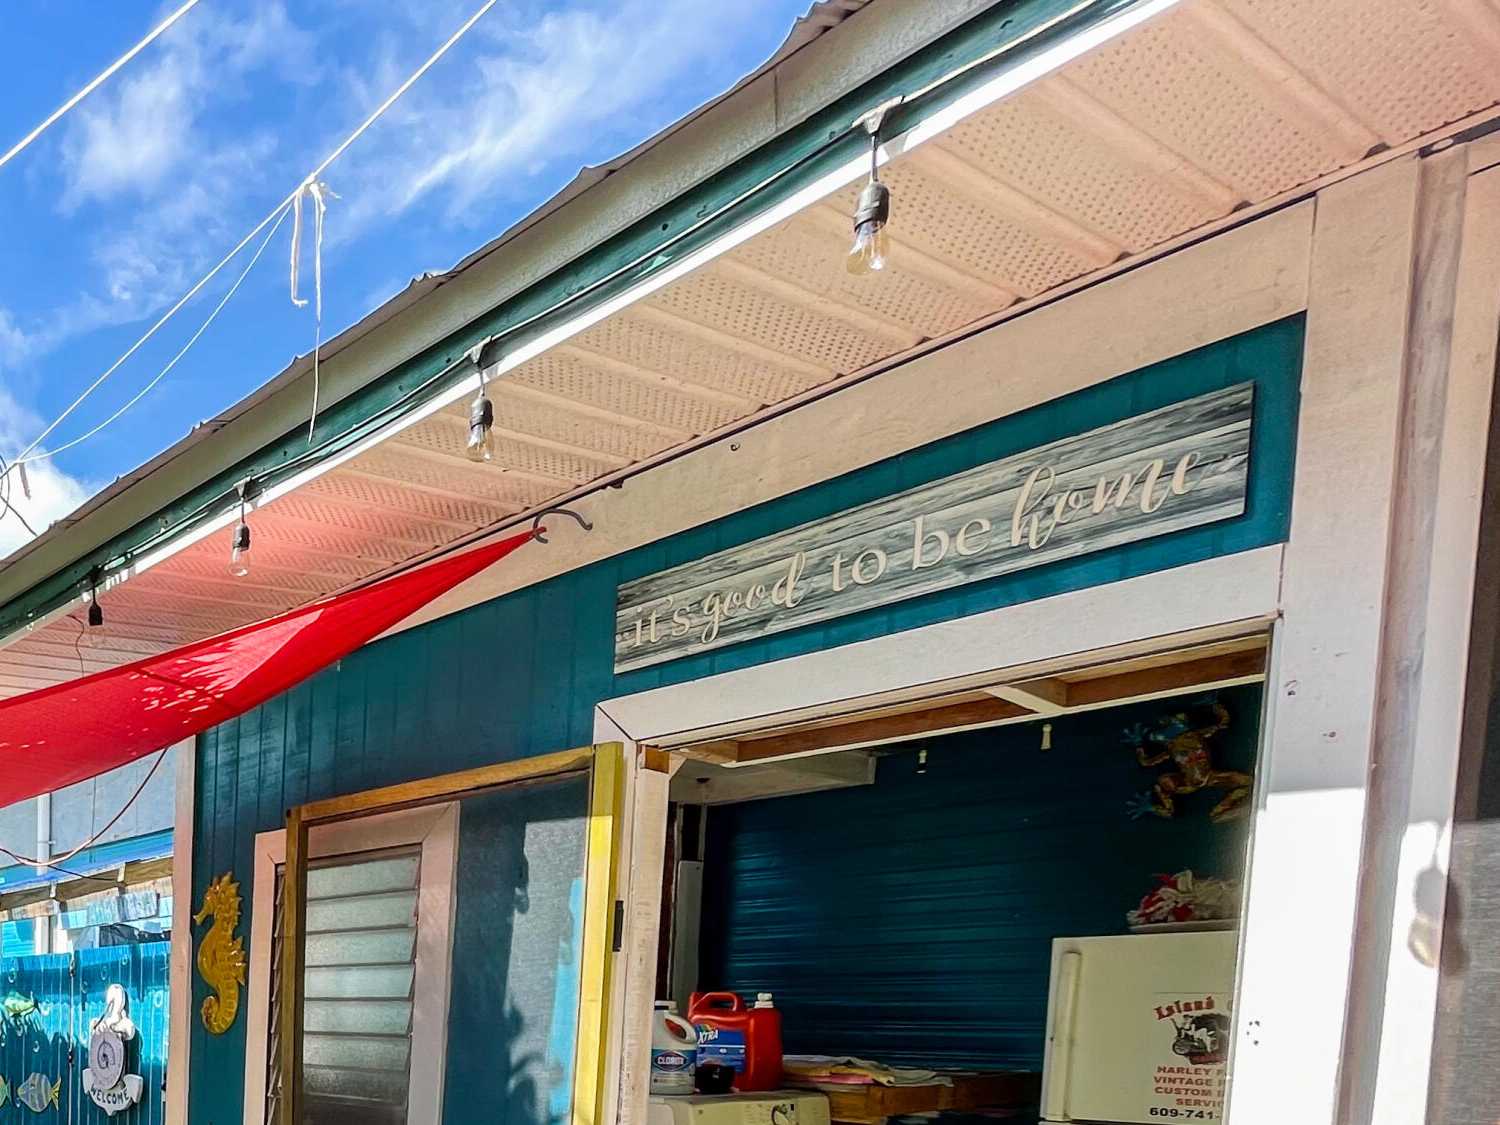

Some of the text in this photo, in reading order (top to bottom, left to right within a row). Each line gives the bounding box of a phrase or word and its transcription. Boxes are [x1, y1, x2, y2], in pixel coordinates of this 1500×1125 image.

[632, 451, 1202, 648] it's good to be home
[1153, 996, 1215, 1020] Island
[697, 1029, 719, 1045] XTRA
[1156, 1066, 1212, 1076] HARLEY
[1154, 1076, 1213, 1087] VINTAGE
[91, 1083, 129, 1105] WELCOME
[1154, 1086, 1213, 1097] CUSTOM
